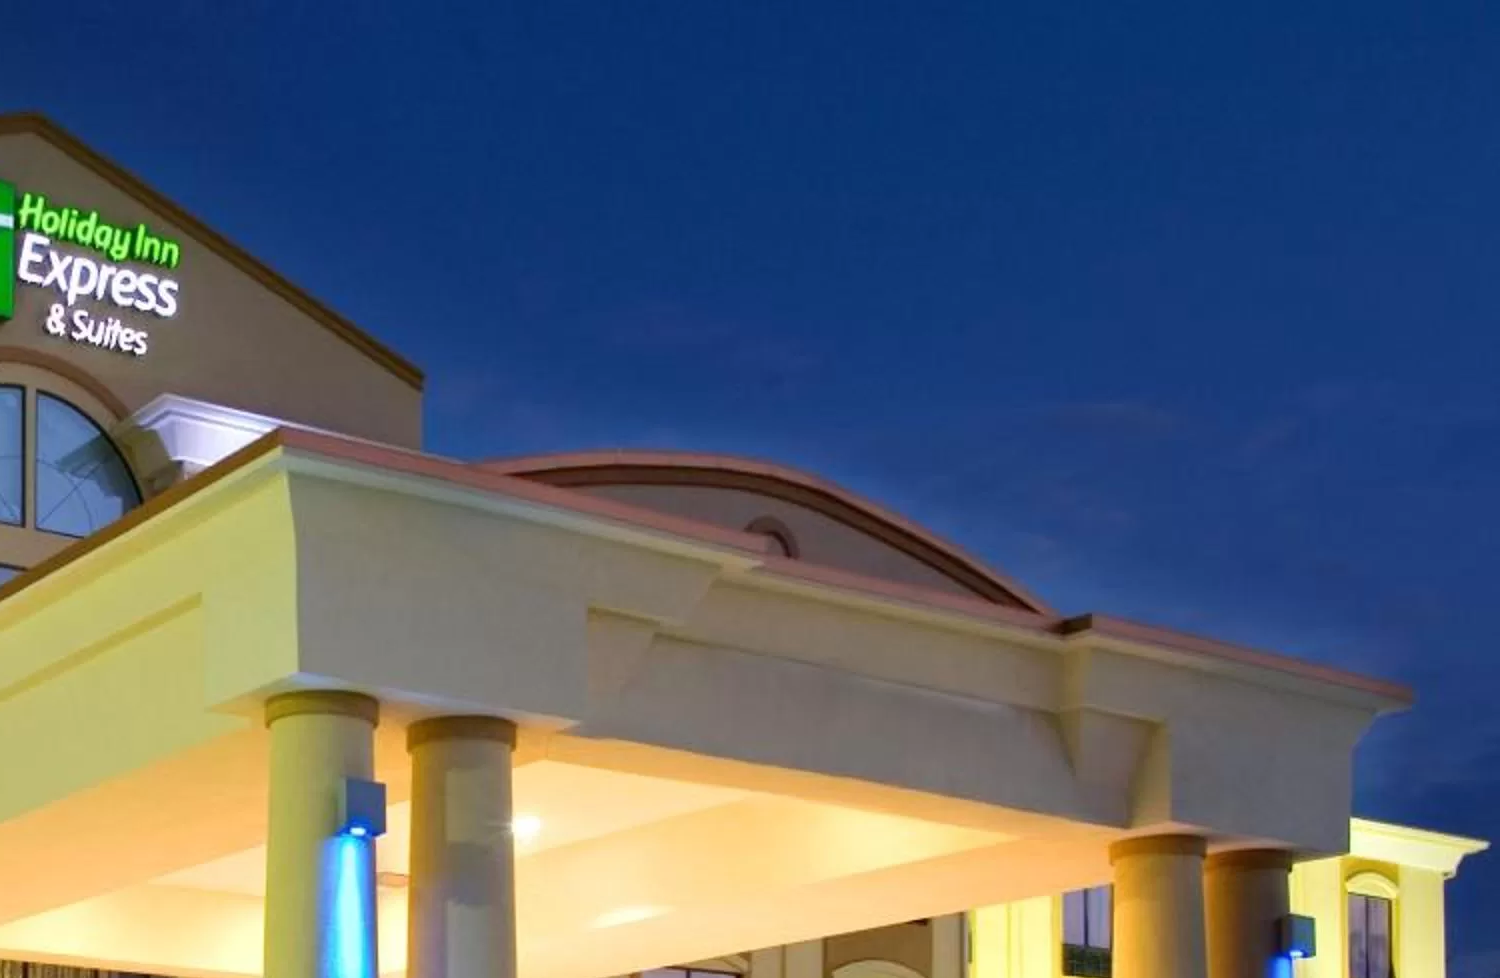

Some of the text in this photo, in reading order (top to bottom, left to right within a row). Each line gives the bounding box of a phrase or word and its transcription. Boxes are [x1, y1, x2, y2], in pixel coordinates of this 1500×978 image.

[19, 192, 181, 268] Holiday Inn
[17, 231, 180, 318] Express
[45, 302, 149, 356] & Suites
